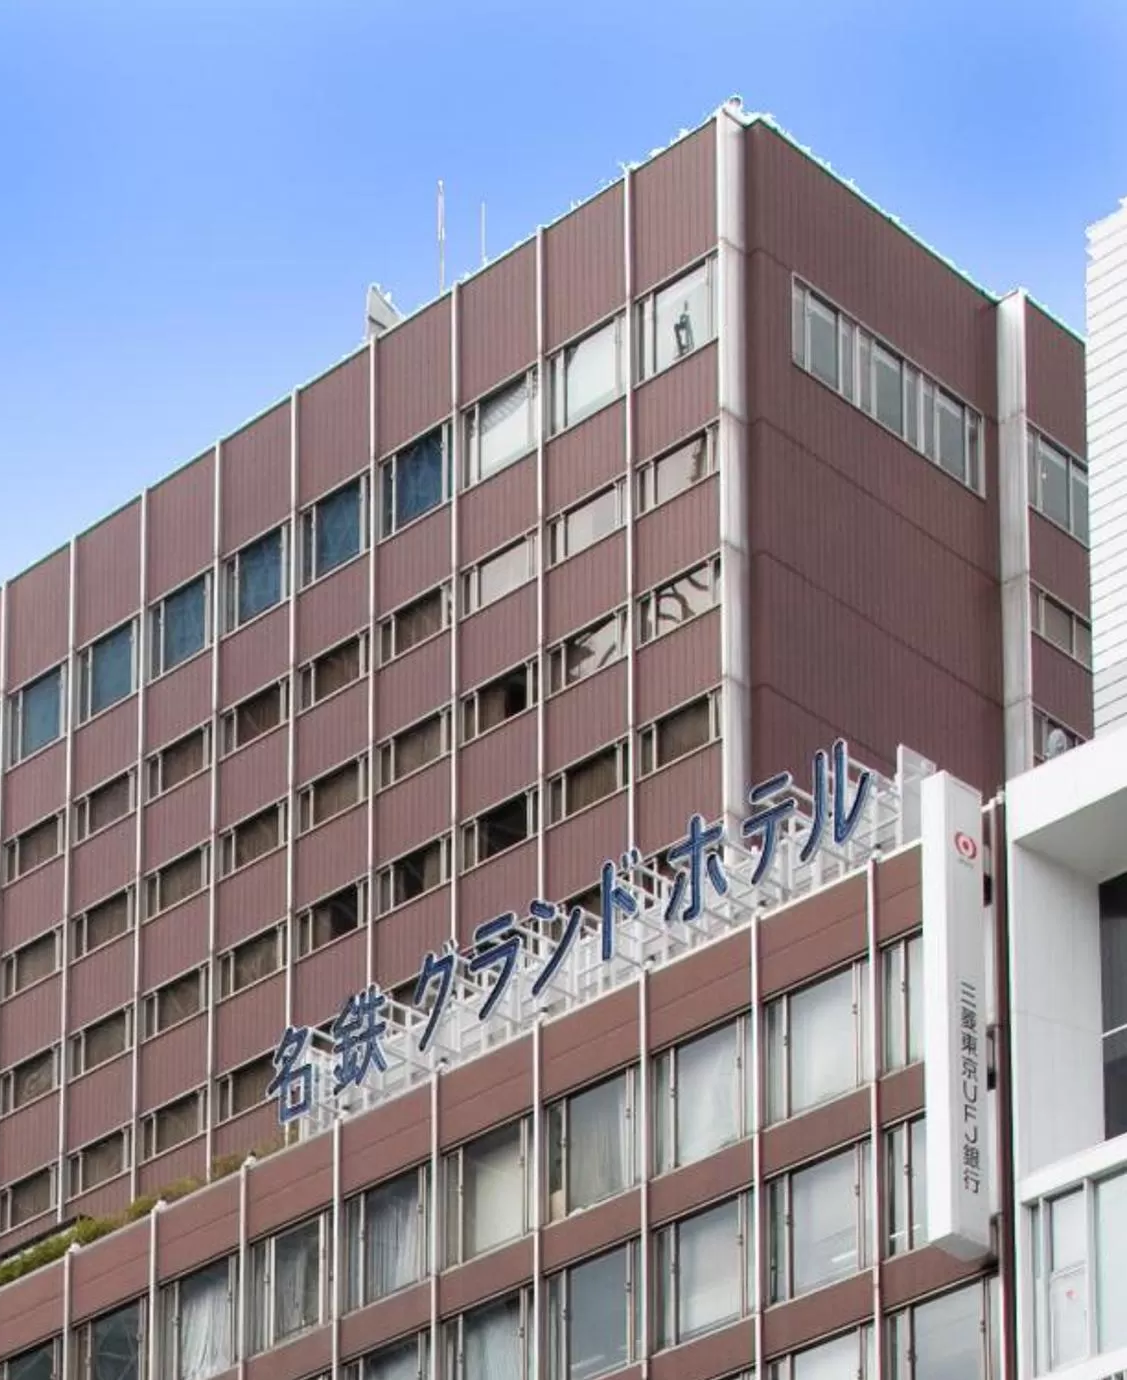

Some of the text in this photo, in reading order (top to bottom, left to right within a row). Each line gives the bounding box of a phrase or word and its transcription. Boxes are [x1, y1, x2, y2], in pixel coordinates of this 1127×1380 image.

[267, 738, 872, 1124] 名鉄グランドホテル
